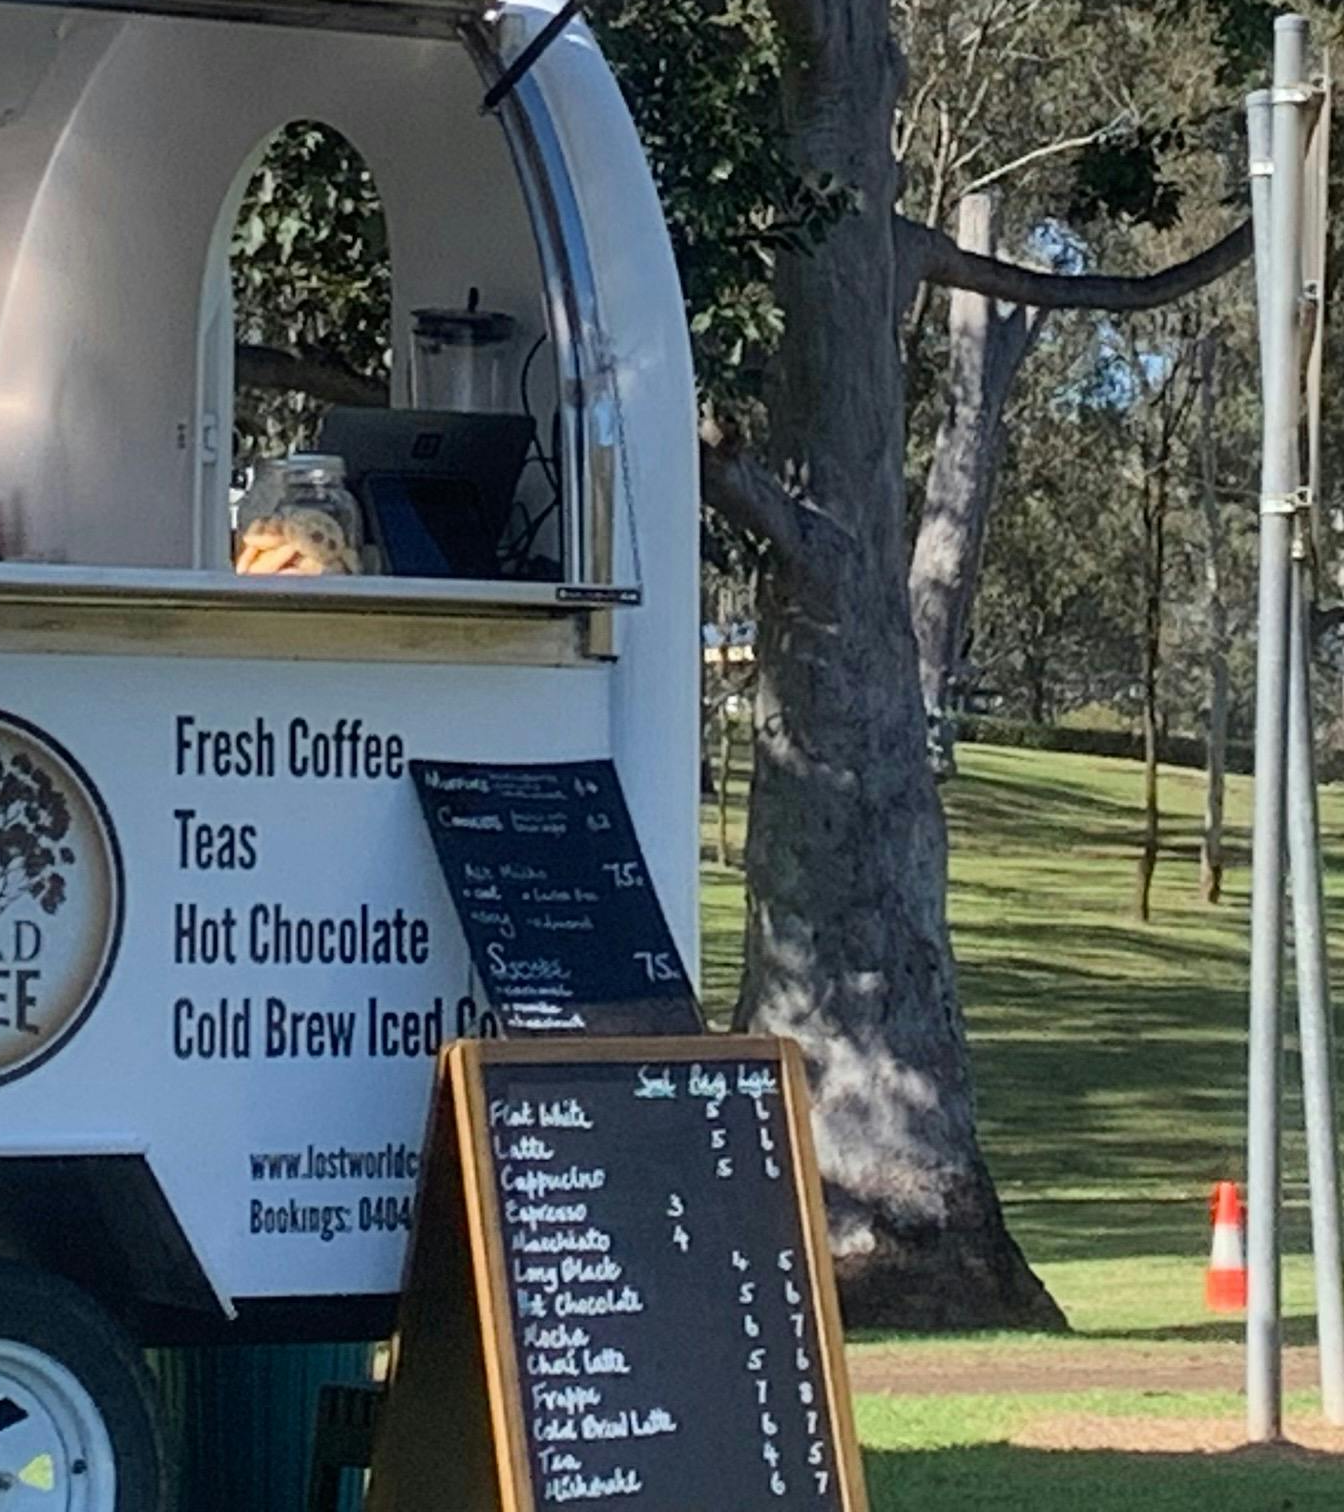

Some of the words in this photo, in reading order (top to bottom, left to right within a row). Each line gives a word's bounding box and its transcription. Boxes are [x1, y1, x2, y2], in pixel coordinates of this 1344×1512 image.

[175, 715, 275, 777] Fresh
[289, 716, 404, 779] Coffee
[174, 809, 257, 870] Teas
[173, 903, 237, 965] Hot
[249, 903, 429, 965] Chocolate
[173, 997, 251, 1060] Cold
[265, 997, 356, 1059] Brew
[368, 997, 443, 1057] Iced
[490, 1099, 535, 1128] Flat
[539, 1099, 593, 1129] White
[493, 1135, 555, 1161] Latte
[711, 1129, 726, 1149] 5
[760, 1128, 774, 1150] 6
[716, 1158, 733, 1178] 5
[765, 1157, 780, 1179] 6
[250, 1198, 353, 1242] Bookings:
[359, 1196, 419, 1232] 0404
[667, 1194, 684, 1217] 3
[672, 1225, 690, 1252] 4
[514, 1258, 558, 1294] Long
[560, 1255, 622, 1283] Black
[732, 1250, 749, 1271] 4
[778, 1250, 793, 1271] 5
[554, 1285, 644, 1318] Chocolate
[739, 1282, 754, 1304] 5
[785, 1281, 801, 1304] 6
[524, 1322, 590, 1349] Mocha
[744, 1314, 760, 1337] 6
[790, 1314, 804, 1338] 7
[527, 1348, 580, 1377] Chai
[748, 1349, 766, 1370] 5
[796, 1348, 810, 1370] 6
[799, 1381, 814, 1404] 8
[761, 1412, 778, 1435] 6
[538, 1445, 582, 1474] Tea
[763, 1442, 780, 1468] 4
[808, 1442, 824, 1464] 5
[770, 1472, 786, 1495] 6
[815, 1471, 828, 1495] 7
